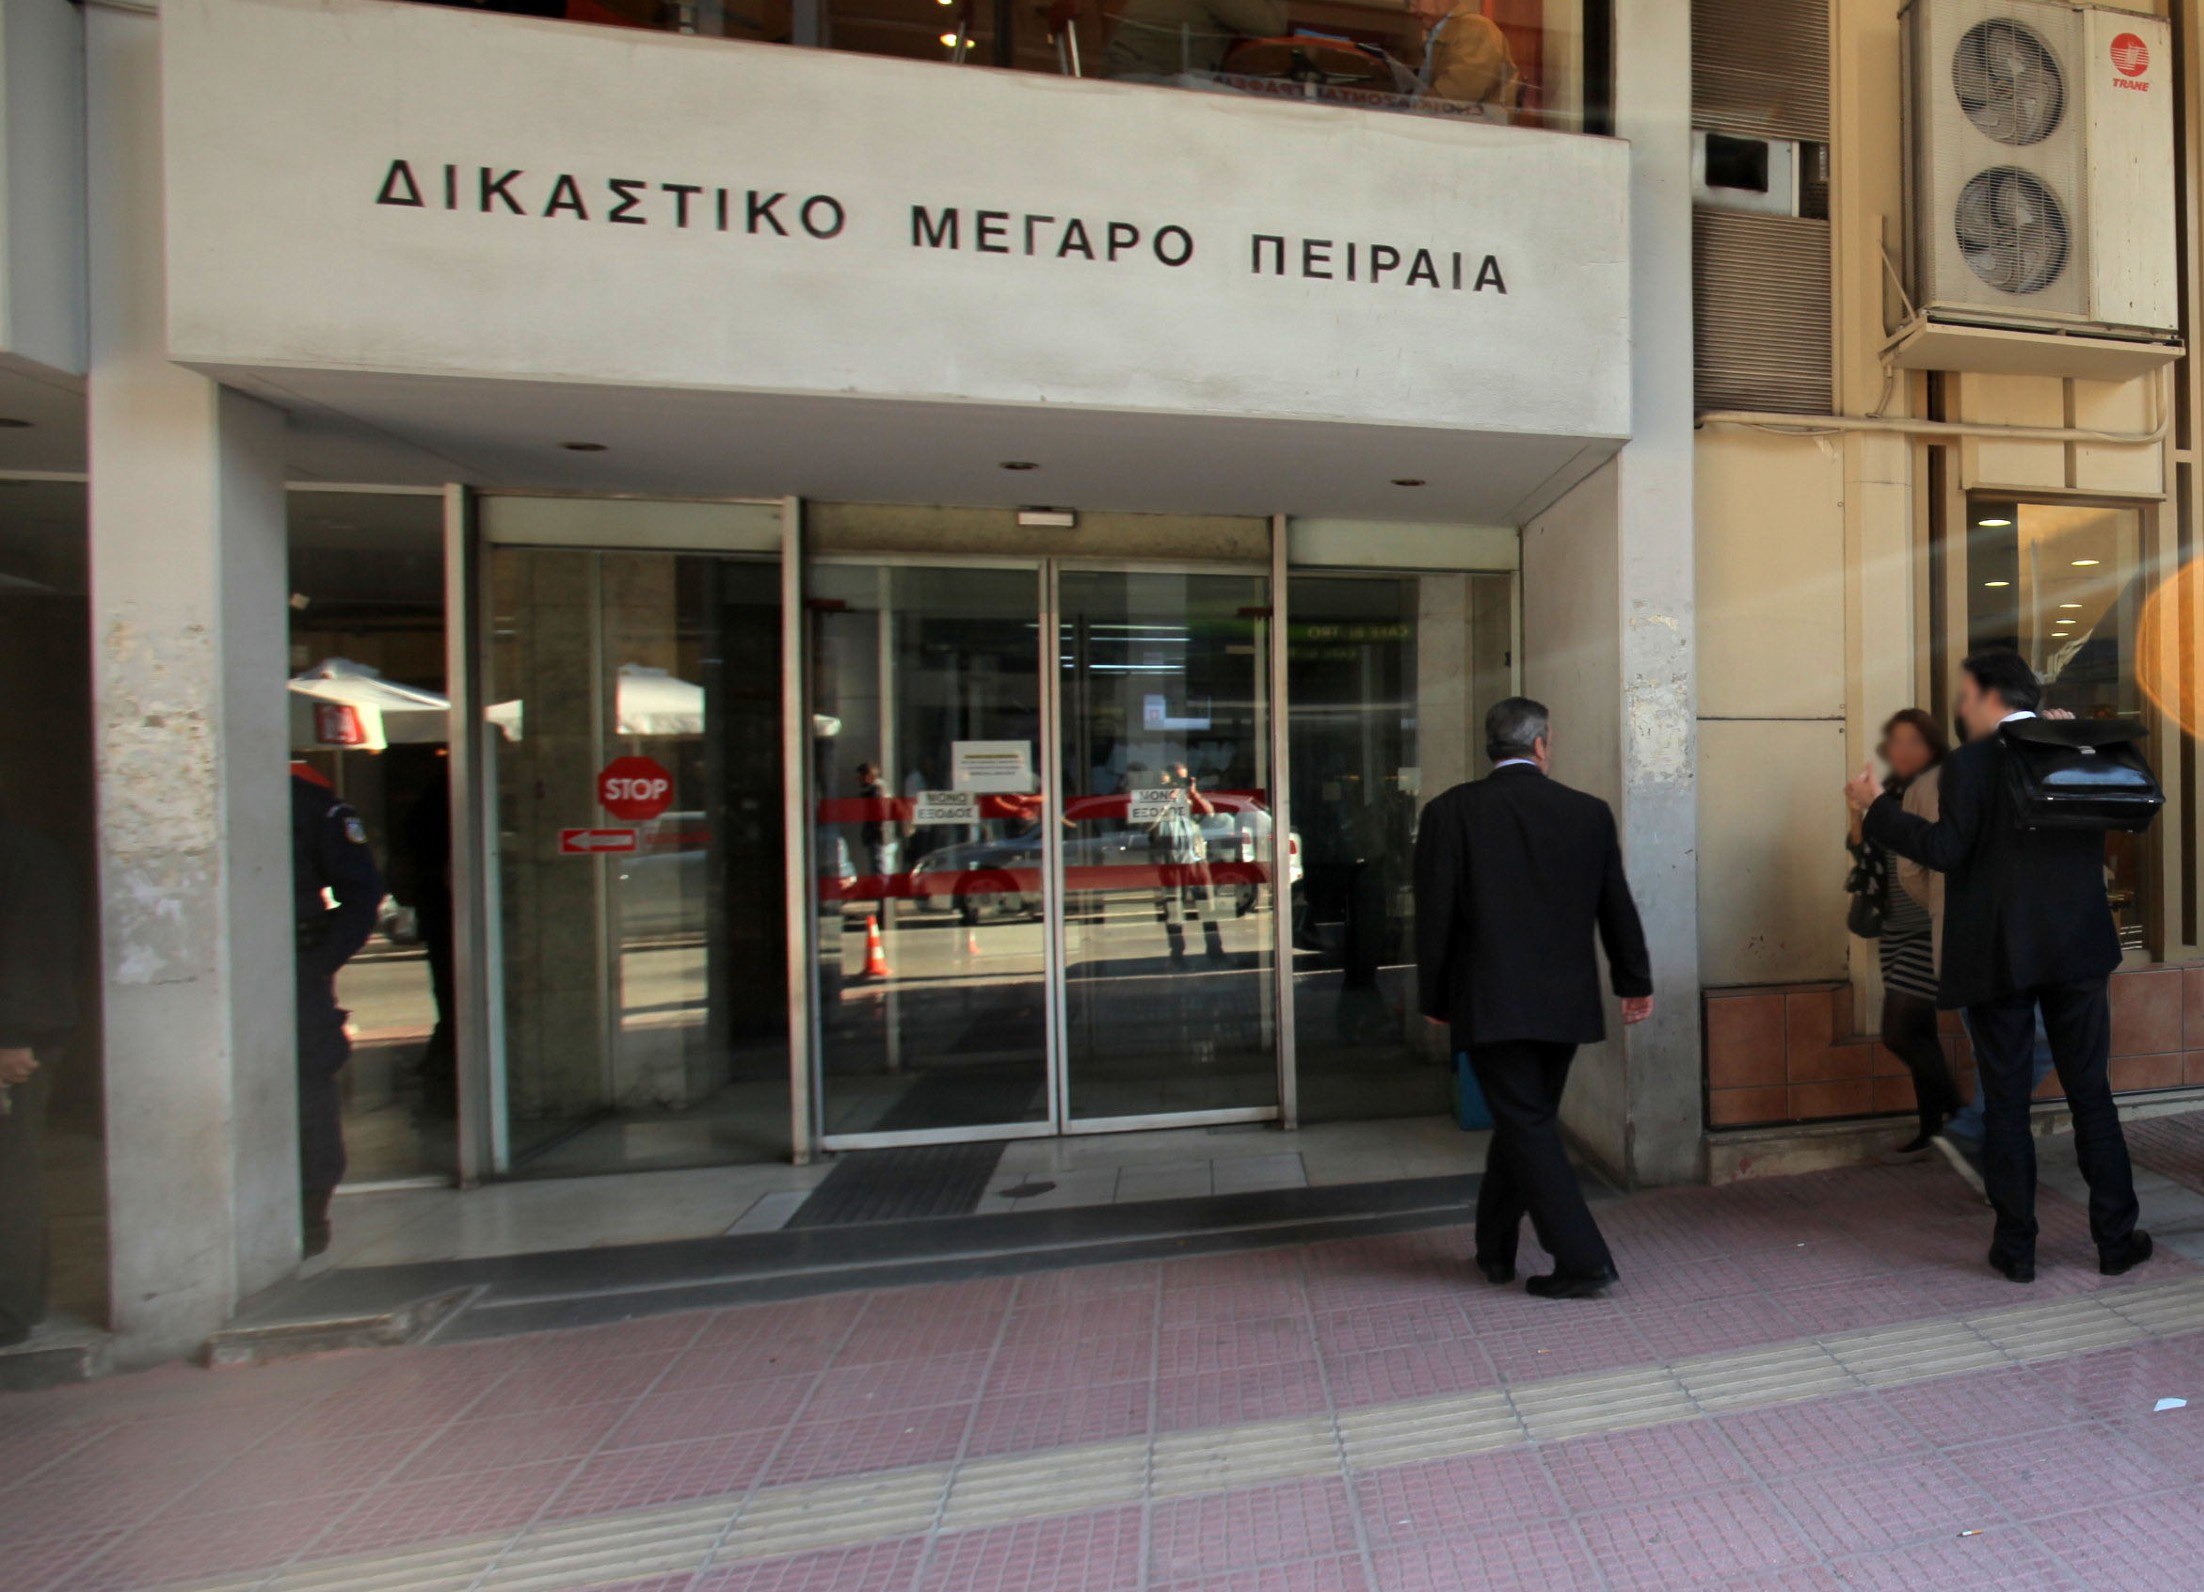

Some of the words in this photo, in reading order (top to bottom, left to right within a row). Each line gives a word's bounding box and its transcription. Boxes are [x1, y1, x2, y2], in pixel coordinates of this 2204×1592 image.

[2112, 77, 2149, 92] TRANE
[376, 159, 846, 240] ΔΙΚΑΣΤΙΚΟ
[912, 205, 1193, 268] ΜΕΓΑΡΟ
[1252, 234, 1507, 294] ΠΕΙΡΑΙΑ
[604, 777, 670, 801] STOP
